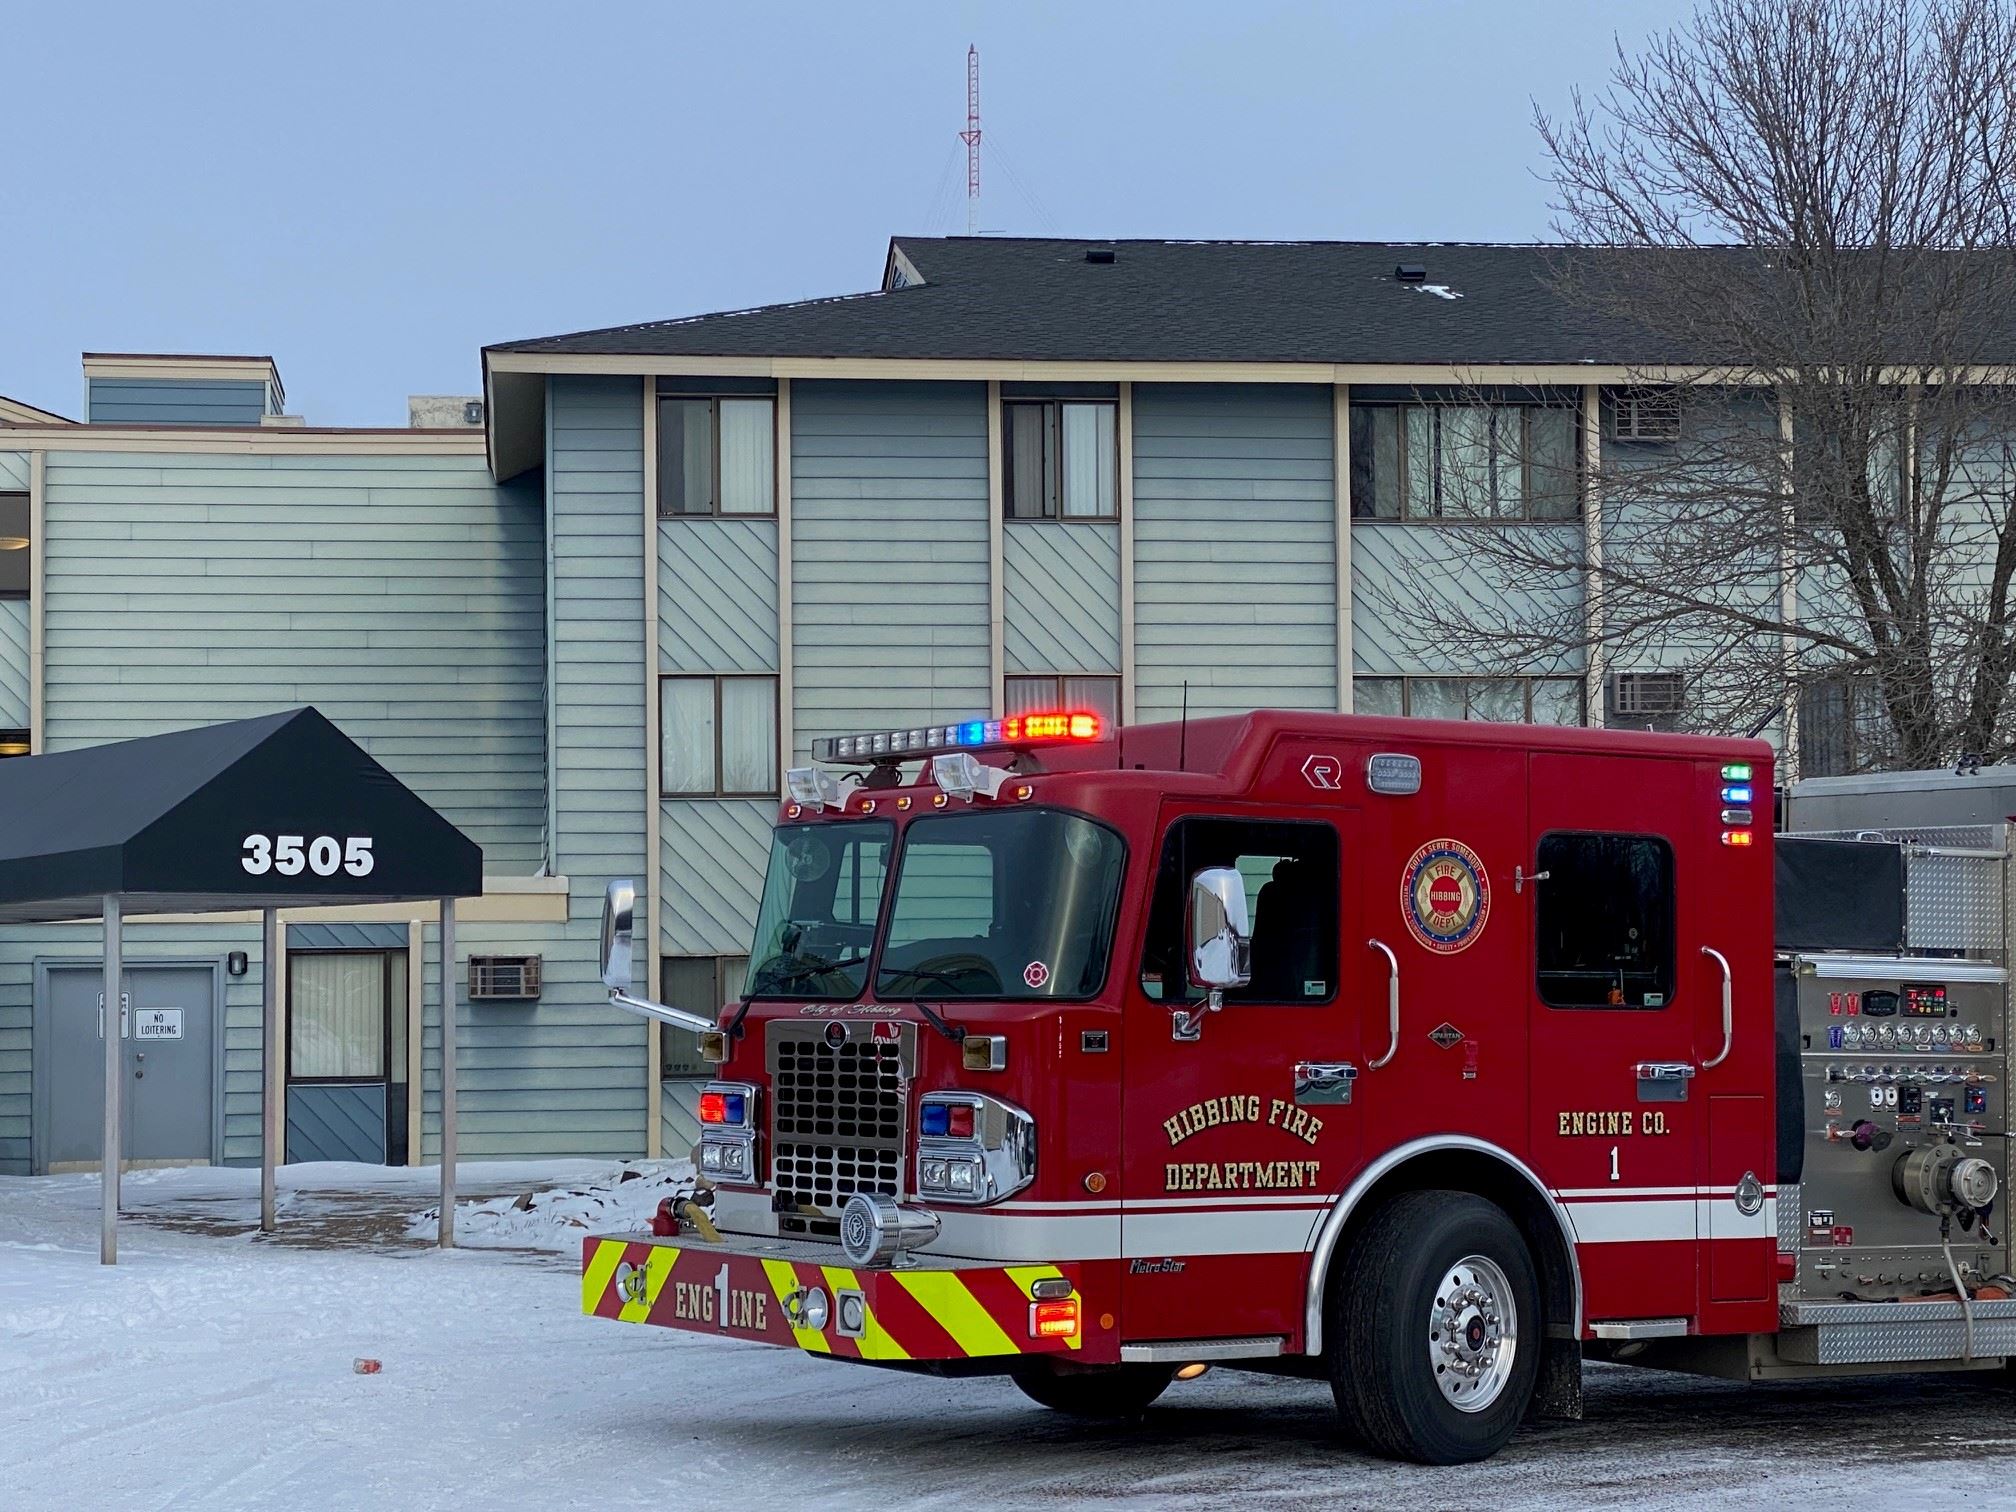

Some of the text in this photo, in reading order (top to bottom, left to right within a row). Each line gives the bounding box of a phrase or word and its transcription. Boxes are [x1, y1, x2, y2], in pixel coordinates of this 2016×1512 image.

[241, 834, 374, 877] 3505
[1409, 841, 1482, 871] GOTTA SERVE SOMEBODY
[1435, 864, 1455, 876] FIRE
[1430, 891, 1461, 901] HIBBING
[1433, 916, 1459, 928] DEPT.
[153, 1013, 164, 1024] NO
[800, 1004, 902, 1017] City of Hibbing
[141, 1025, 177, 1035] LOITERING
[1163, 1095, 1324, 1146] HIBBING FIRE
[1559, 1111, 1670, 1135] ENGINE CO.
[1610, 1145, 1620, 1180] 1
[1165, 1161, 1320, 1191] DEPARTMENT
